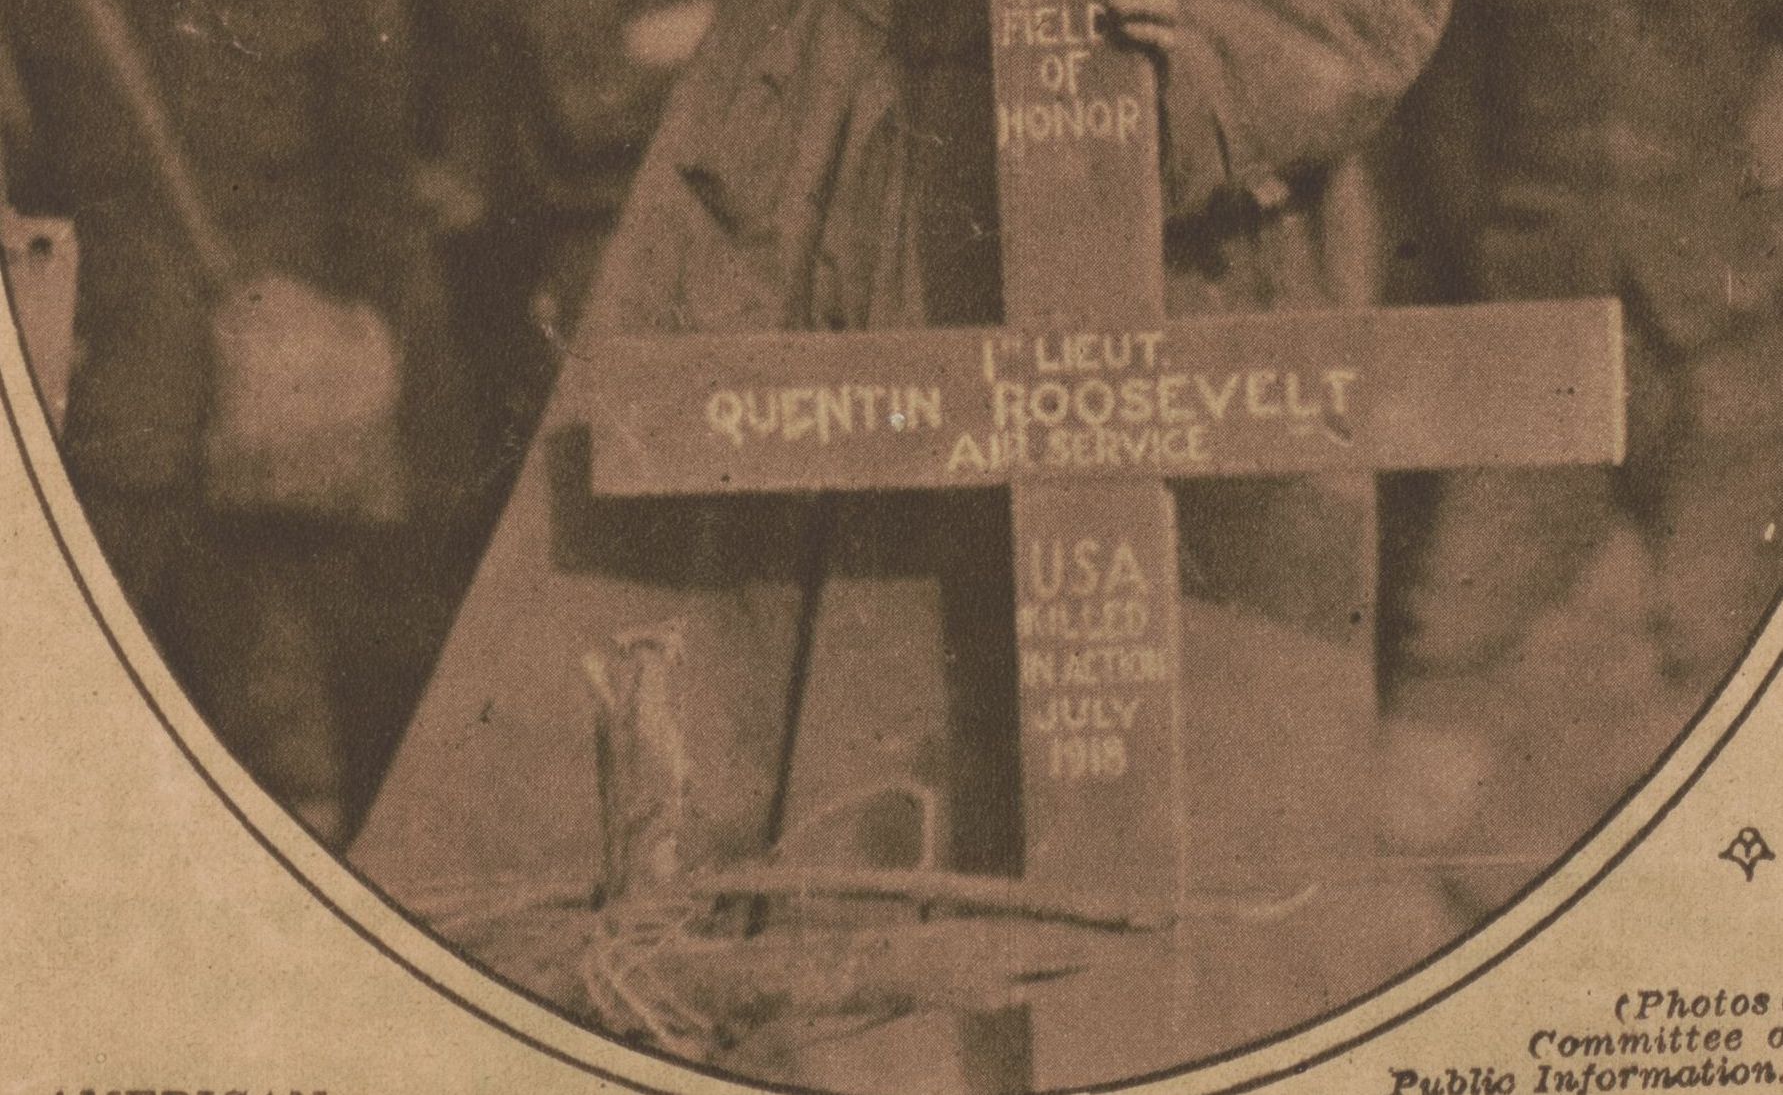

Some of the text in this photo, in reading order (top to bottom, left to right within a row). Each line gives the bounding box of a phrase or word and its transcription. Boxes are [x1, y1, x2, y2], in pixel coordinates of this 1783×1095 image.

[1040, 50, 1090, 94] OF
[997, 96, 1140, 149] HONOR
[705, 369, 1357, 447] QUENTIN ROOSEVELT
[948, 424, 1212, 473] AIR SERVICE
[1031, 537, 1149, 600] USA
[1017, 600, 1150, 640] KILLED
[1062, 647, 1168, 684] ACTION
[1034, 696, 1141, 733] JULY
[1049, 736, 1128, 779] 1918
[1614, 989, 1770, 1025] (Photos
[1528, 1026, 1744, 1060] Committee
[1389, 1066, 1516, 1095] Public
